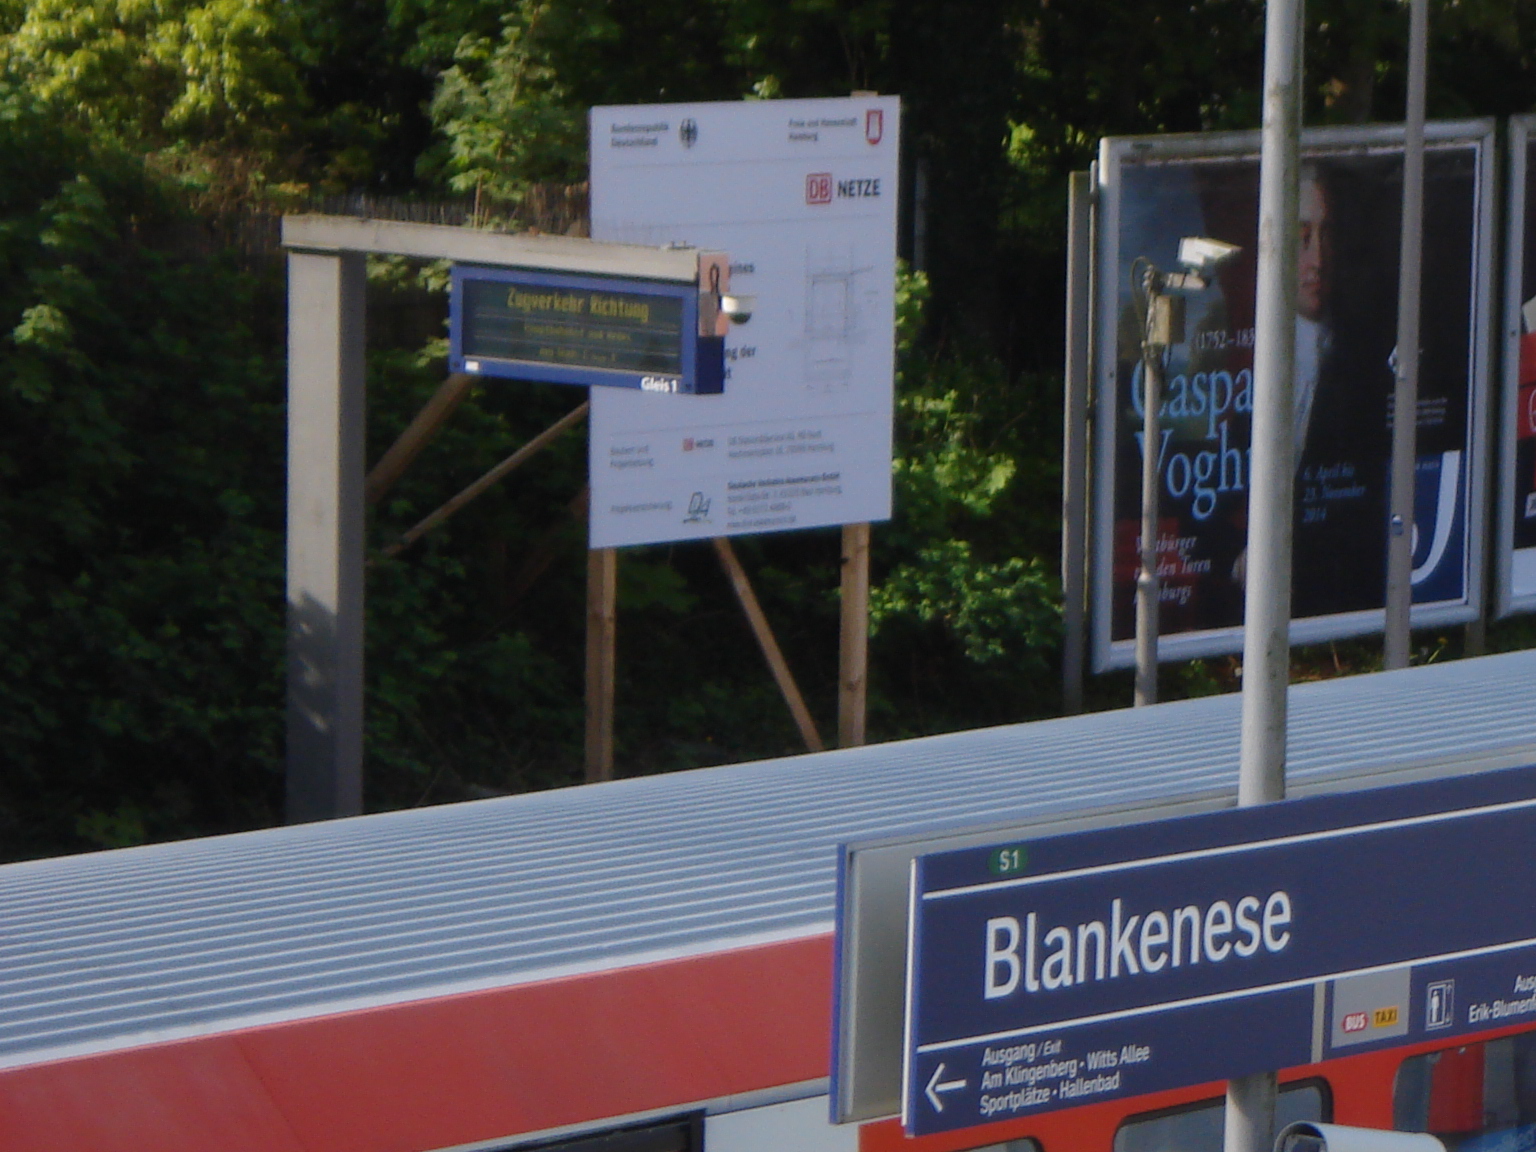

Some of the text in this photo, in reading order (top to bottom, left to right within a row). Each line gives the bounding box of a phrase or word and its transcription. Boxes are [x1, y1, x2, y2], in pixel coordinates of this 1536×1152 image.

[807, 174, 881, 203] DB NETZE
[589, 294, 649, 322] Richtung
[641, 375, 678, 392] Gleis 1
[1131, 357, 1255, 439] Caspa
[1133, 419, 1252, 521] Vogh
[1000, 849, 1020, 872] S1
[984, 890, 1293, 1000] Blankenese
[1344, 1013, 1367, 1032] BUS
[1374, 1007, 1398, 1024] TAXI
[980, 1043, 1150, 1091] Am Klingenberg Witts Allee
[981, 1041, 1036, 1067] Ausgang
[979, 1070, 1121, 1117] Sportplätze Hallenbad
